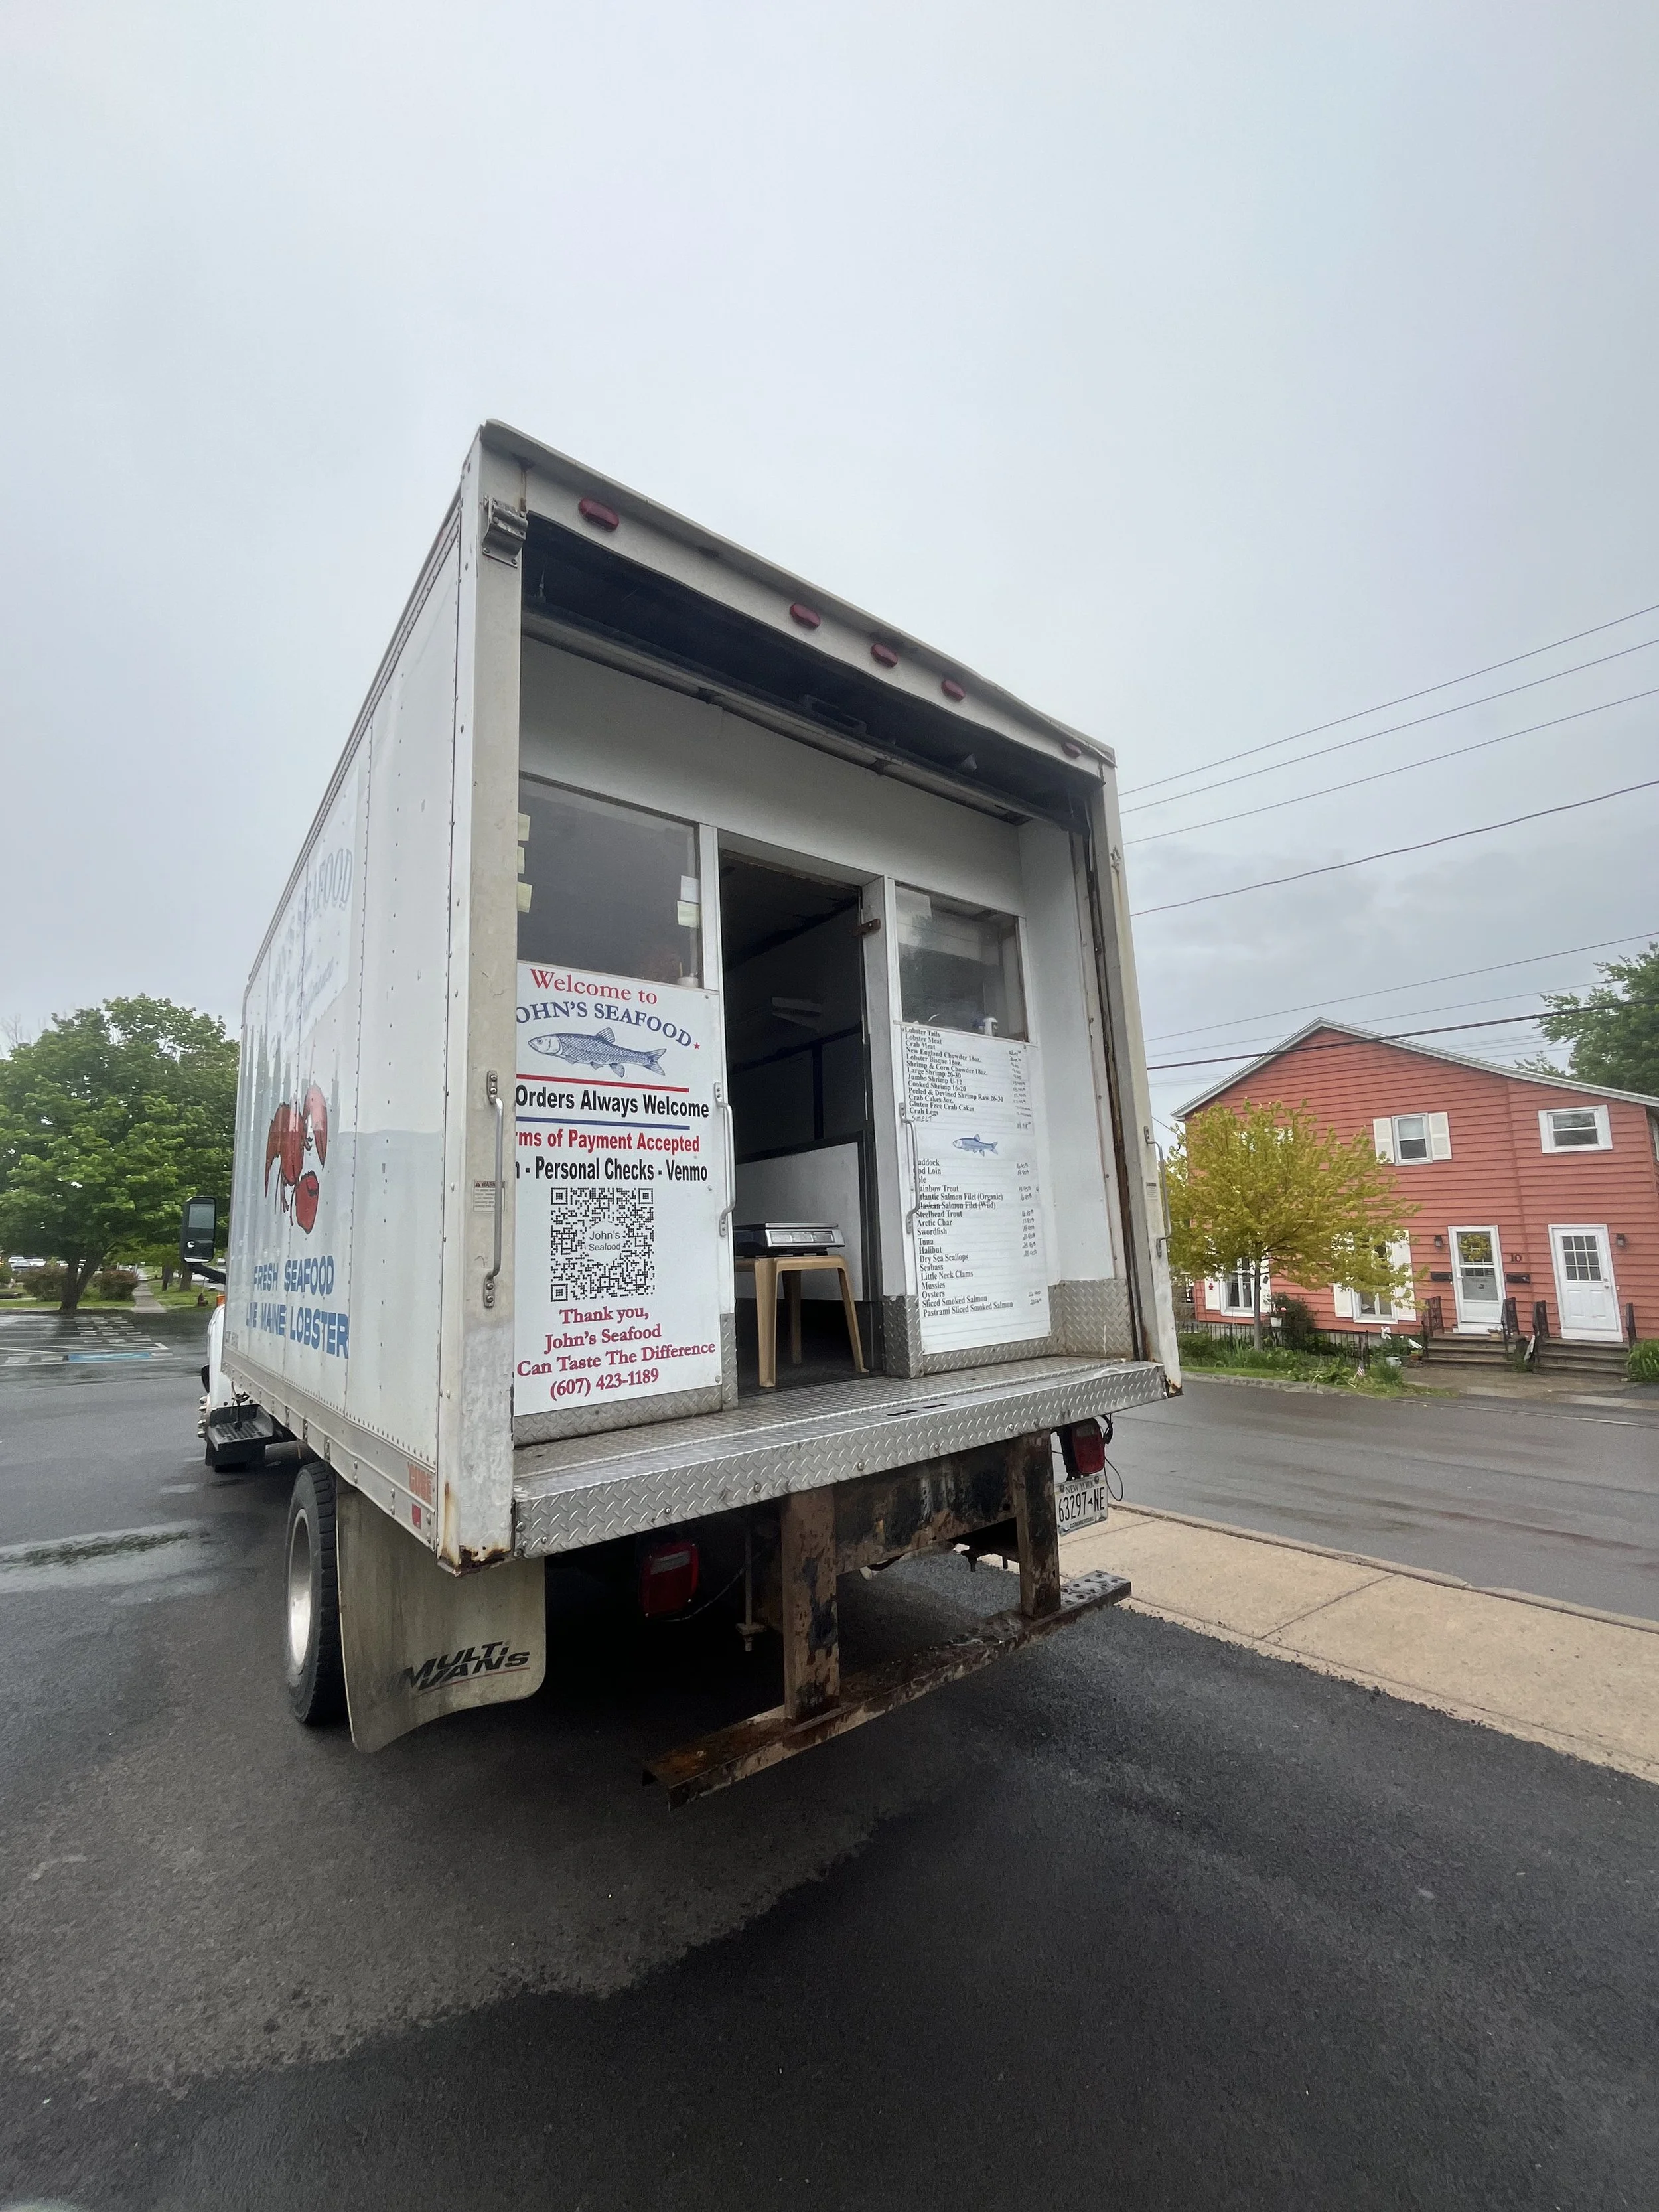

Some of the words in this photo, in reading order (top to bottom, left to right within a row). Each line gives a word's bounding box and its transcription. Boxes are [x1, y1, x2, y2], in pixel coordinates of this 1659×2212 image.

[530, 968, 631, 1001] Welcome
[638, 990, 658, 1005] to
[516, 1001, 587, 1023] OHN'S
[594, 1003, 692, 1047] SEAFOOD
[905, 1027, 926, 1035] Lobster
[905, 1033, 927, 1042] Lobster
[906, 1053, 928, 1062] Lobster
[929, 1056, 947, 1065] Bisque
[920, 1049, 942, 1057] England
[944, 1051, 968, 1061] Chowder
[906, 1061, 928, 1069] Shrimp
[950, 1066, 974, 1074] Chowder
[925, 1069, 946, 1078] Shrimp
[516, 1084, 575, 1109] Orders
[581, 1090, 638, 1118] Always
[643, 1094, 709, 1118] Welcome
[547, 1128, 563, 1147] of
[569, 1129, 632, 1153] Payment
[637, 1132, 700, 1155] Accepted
[536, 1155, 599, 1180] Personal
[605, 1158, 654, 1181] Checks
[666, 1159, 707, 1181] Venmo
[977, 1193, 1003, 1202] (Organic)
[589, 1230, 620, 1240] John's
[589, 1242, 621, 1251] Seafood
[919, 1246, 942, 1254] Halibut
[945, 1253, 969, 1262] Scallops
[920, 1263, 943, 1272] Seabass
[254, 1262, 279, 1291] FRESH
[284, 1256, 334, 1296] SEAFOOD
[921, 1272, 937, 1281] Little
[922, 1299, 940, 1308] Sliced
[942, 1296, 965, 1306] Smoked
[559, 1305, 613, 1325] Thank
[616, 1307, 649, 1323] you,
[924, 1307, 950, 1317] Pastrami
[952, 1305, 969, 1314] Sliced
[261, 1303, 287, 1336] MAINE
[290, 1306, 348, 1359] LOBSTER
[543, 1331, 597, 1355] John's
[601, 1323, 662, 1344] Seafood
[516, 1360, 552, 1377] Can
[557, 1356, 601, 1372] Taste
[605, 1349, 638, 1366] The
[641, 1343, 716, 1362] Difference
[549, 1377, 591, 1401] (607)
[596, 1368, 660, 1390] 423-1189
[1064, 1485, 1080, 1494] NEW
[1080, 1481, 1094, 1491] YORK
